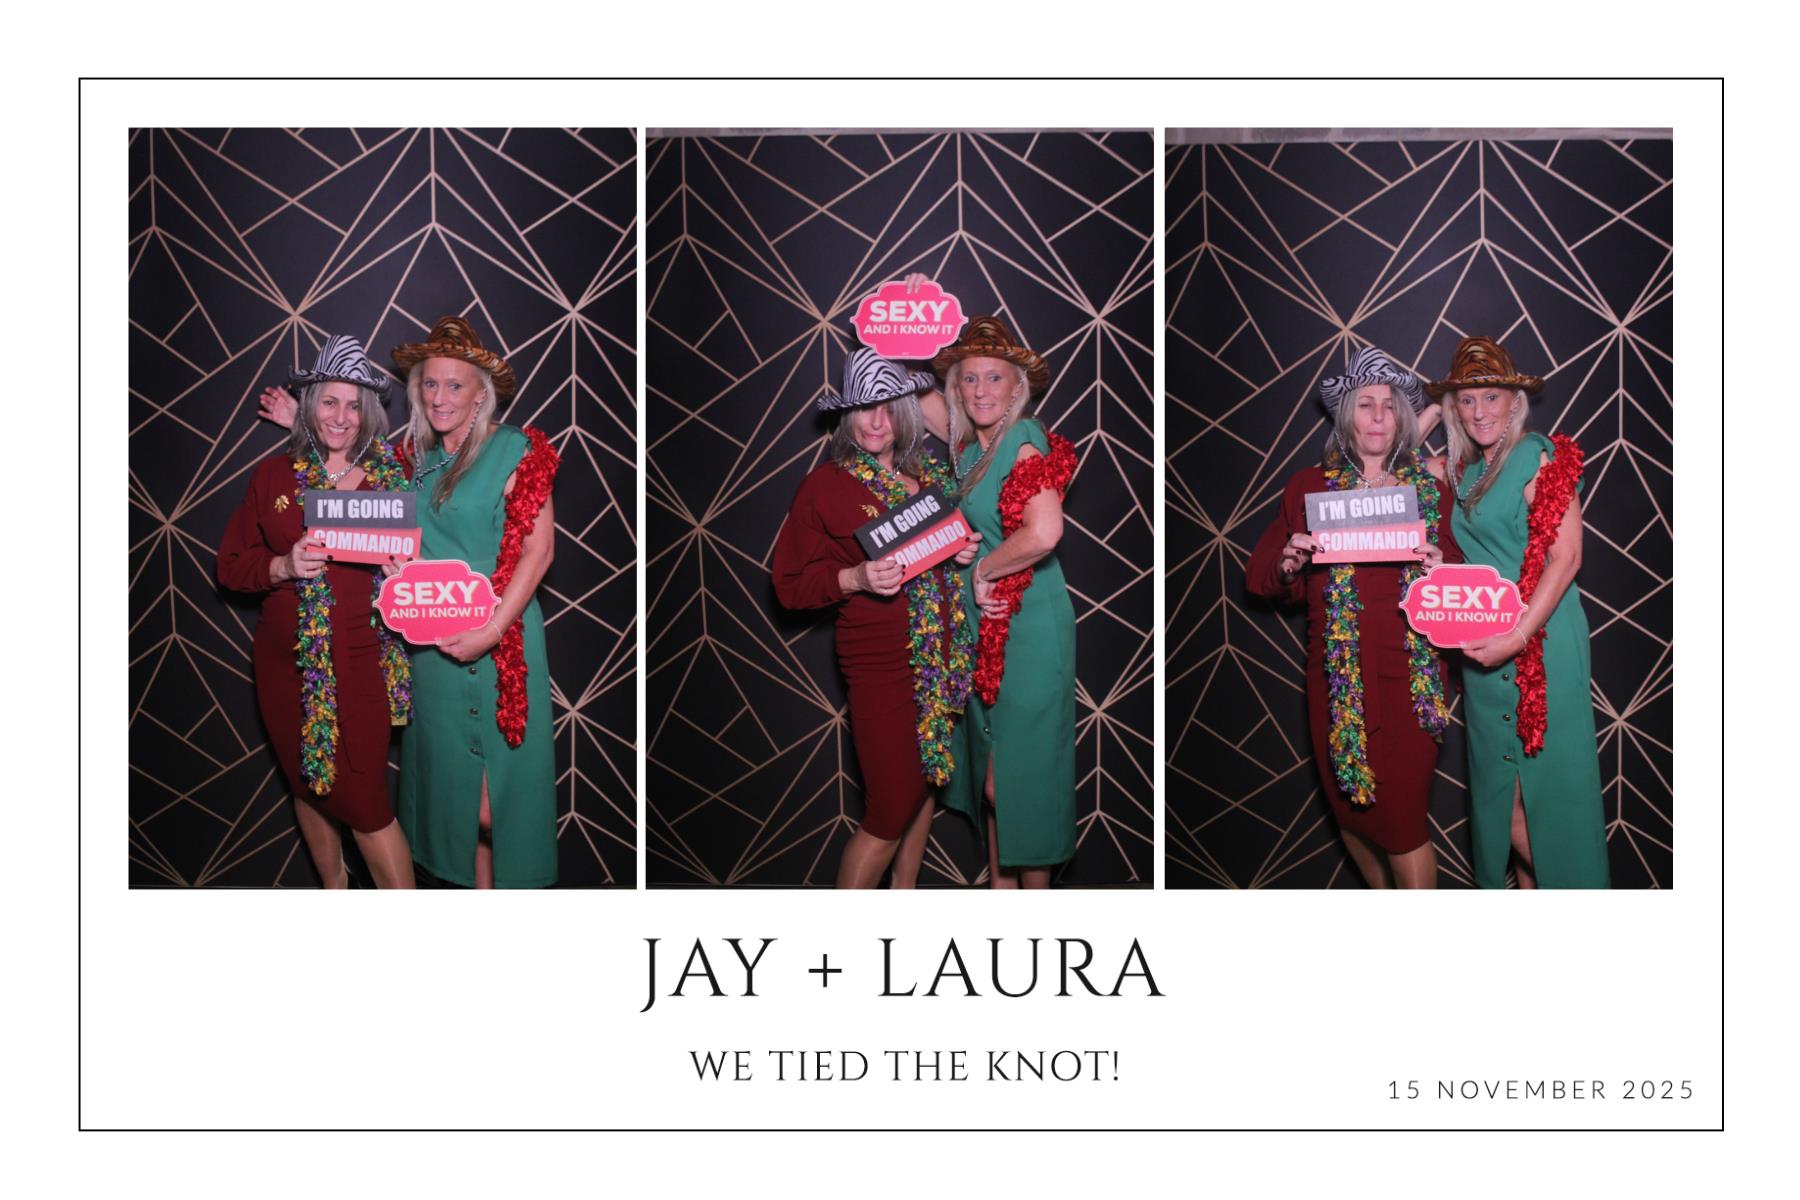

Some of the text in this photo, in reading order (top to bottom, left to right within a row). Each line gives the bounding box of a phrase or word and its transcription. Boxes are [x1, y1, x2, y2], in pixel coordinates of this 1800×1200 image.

[869, 300, 949, 322] SEXY
[863, 324, 954, 334] AND I KNOW IT
[317, 499, 404, 519] I'M GOING
[1319, 493, 1406, 521] I'M GOING
[869, 494, 941, 549] I'M GOING
[885, 520, 966, 569] OMMANDO
[1319, 530, 1420, 552] COMMANDO
[393, 580, 479, 606] SEXY
[1420, 584, 1508, 610] SEXY
[389, 606, 487, 619] AND I KNOW IT
[1415, 611, 1513, 623] AND I KNOW IT
